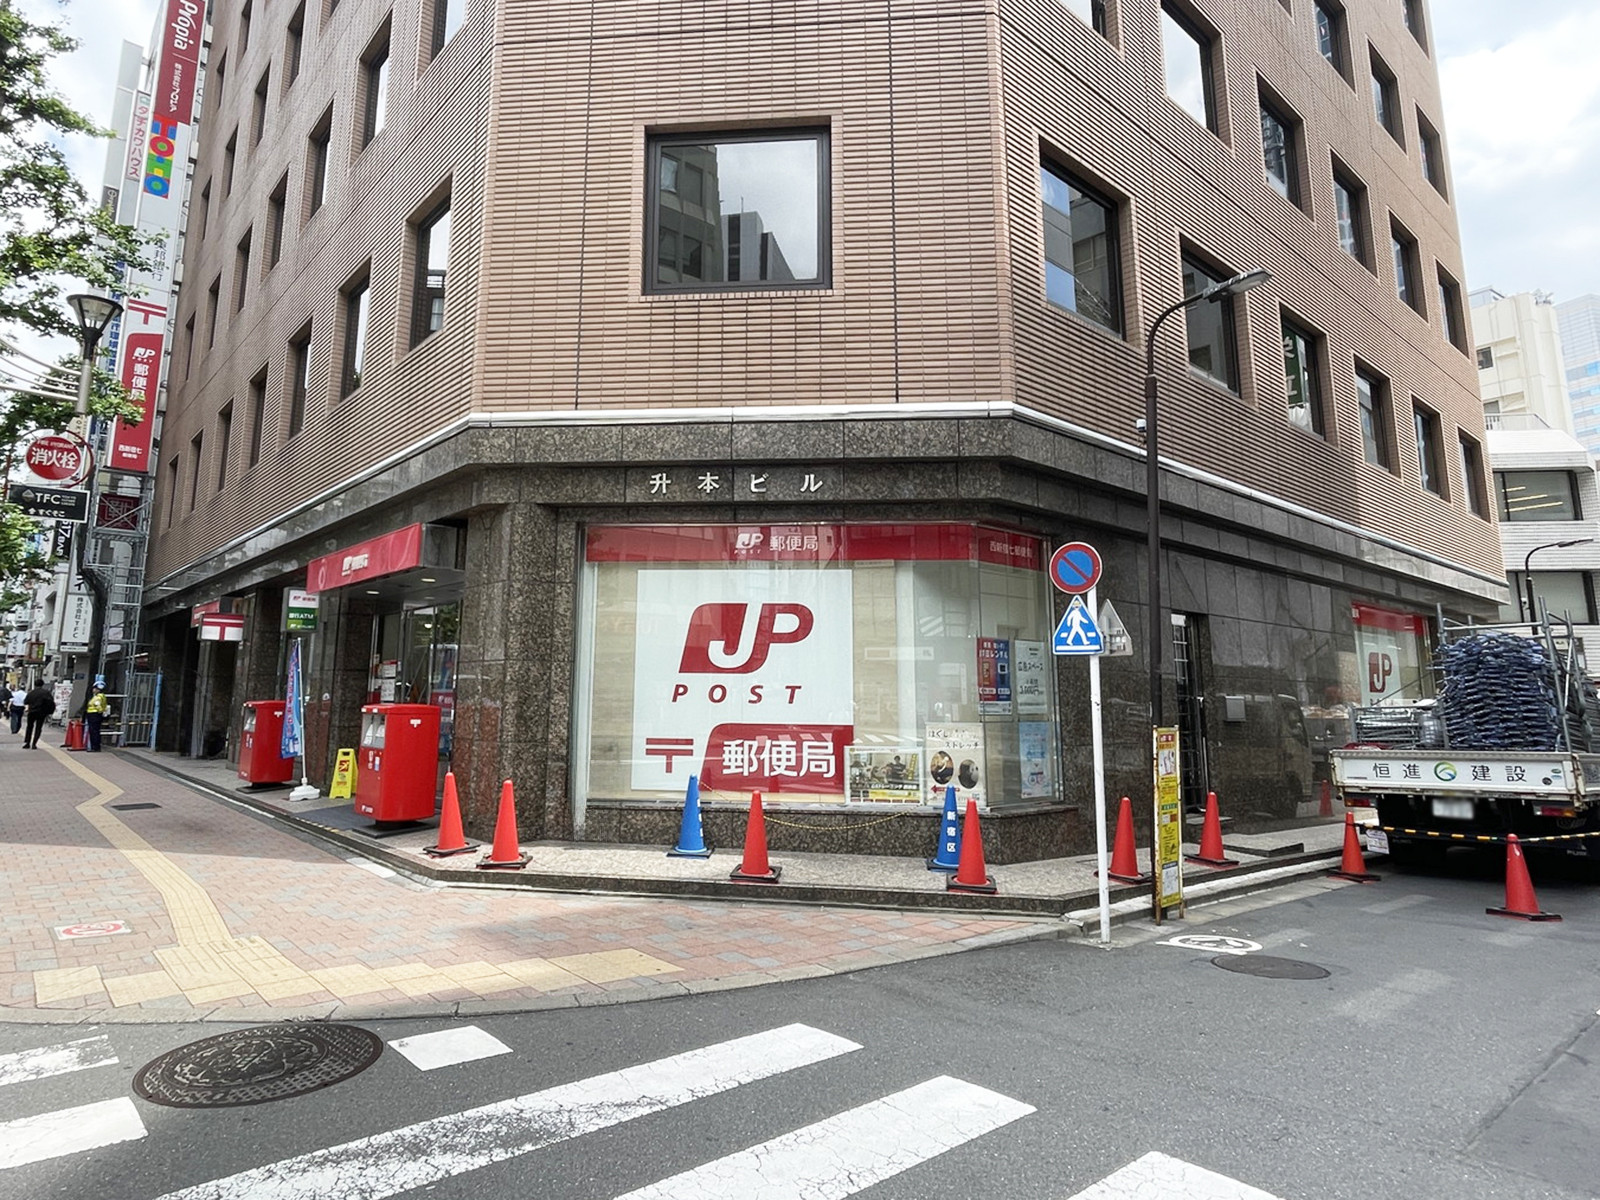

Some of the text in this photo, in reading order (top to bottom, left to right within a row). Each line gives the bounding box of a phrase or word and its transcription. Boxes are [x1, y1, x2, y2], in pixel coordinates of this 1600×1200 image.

[129, 106, 149, 177] タチカワハウス
[30, 446, 78, 470] 消火栓
[649, 472, 823, 494] 升本ビル
[35, 492, 61, 505] TFC
[769, 535, 818, 552] 郵便局
[679, 603, 814, 674] JP
[671, 683, 803, 704] POST
[721, 739, 836, 779] 郵便局
[1372, 763, 1528, 782] 恒進 建設
[946, 810, 956, 853] 新宿区
